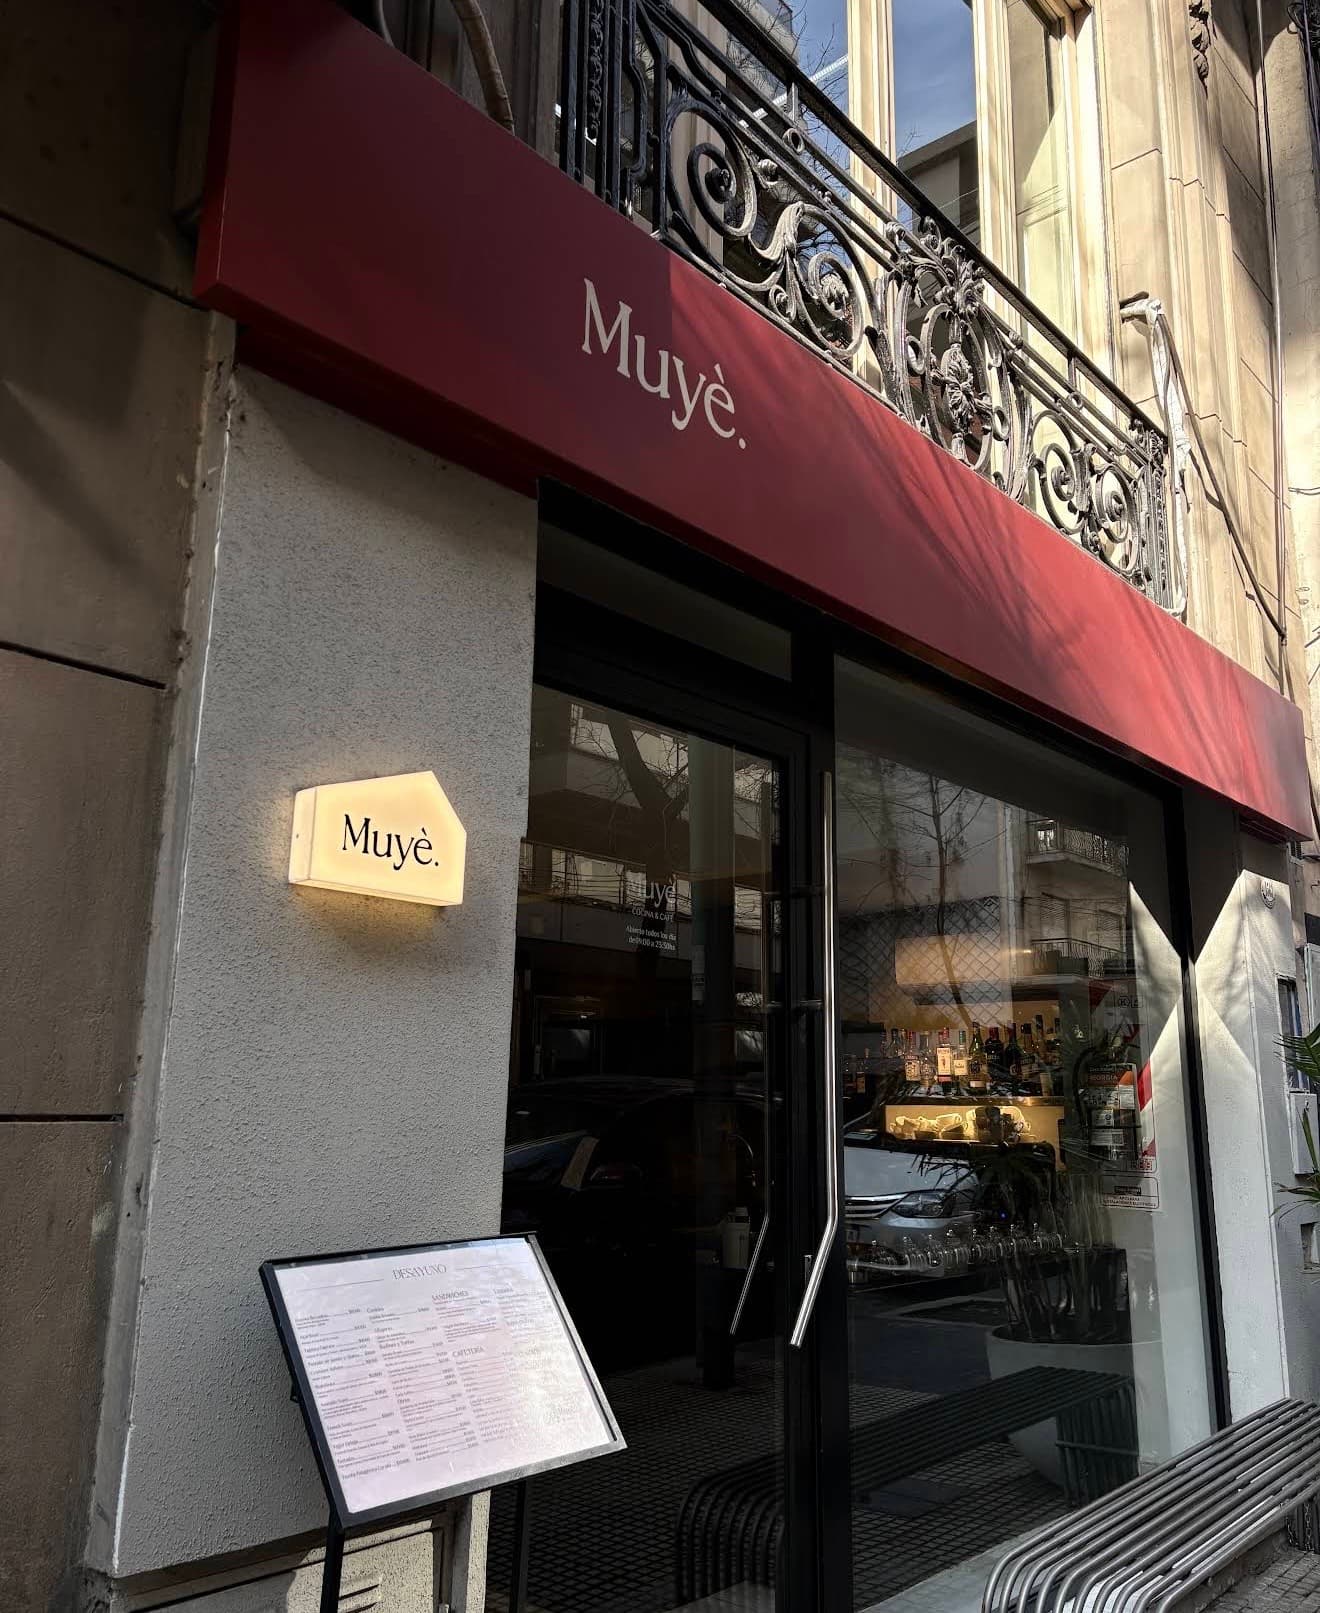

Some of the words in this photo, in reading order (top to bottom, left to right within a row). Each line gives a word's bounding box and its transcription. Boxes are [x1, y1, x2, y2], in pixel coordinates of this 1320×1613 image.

[582, 278, 746, 450] Muyè.
[342, 813, 439, 871] Muyè.
[392, 1263, 447, 1281] DESAYUNO
